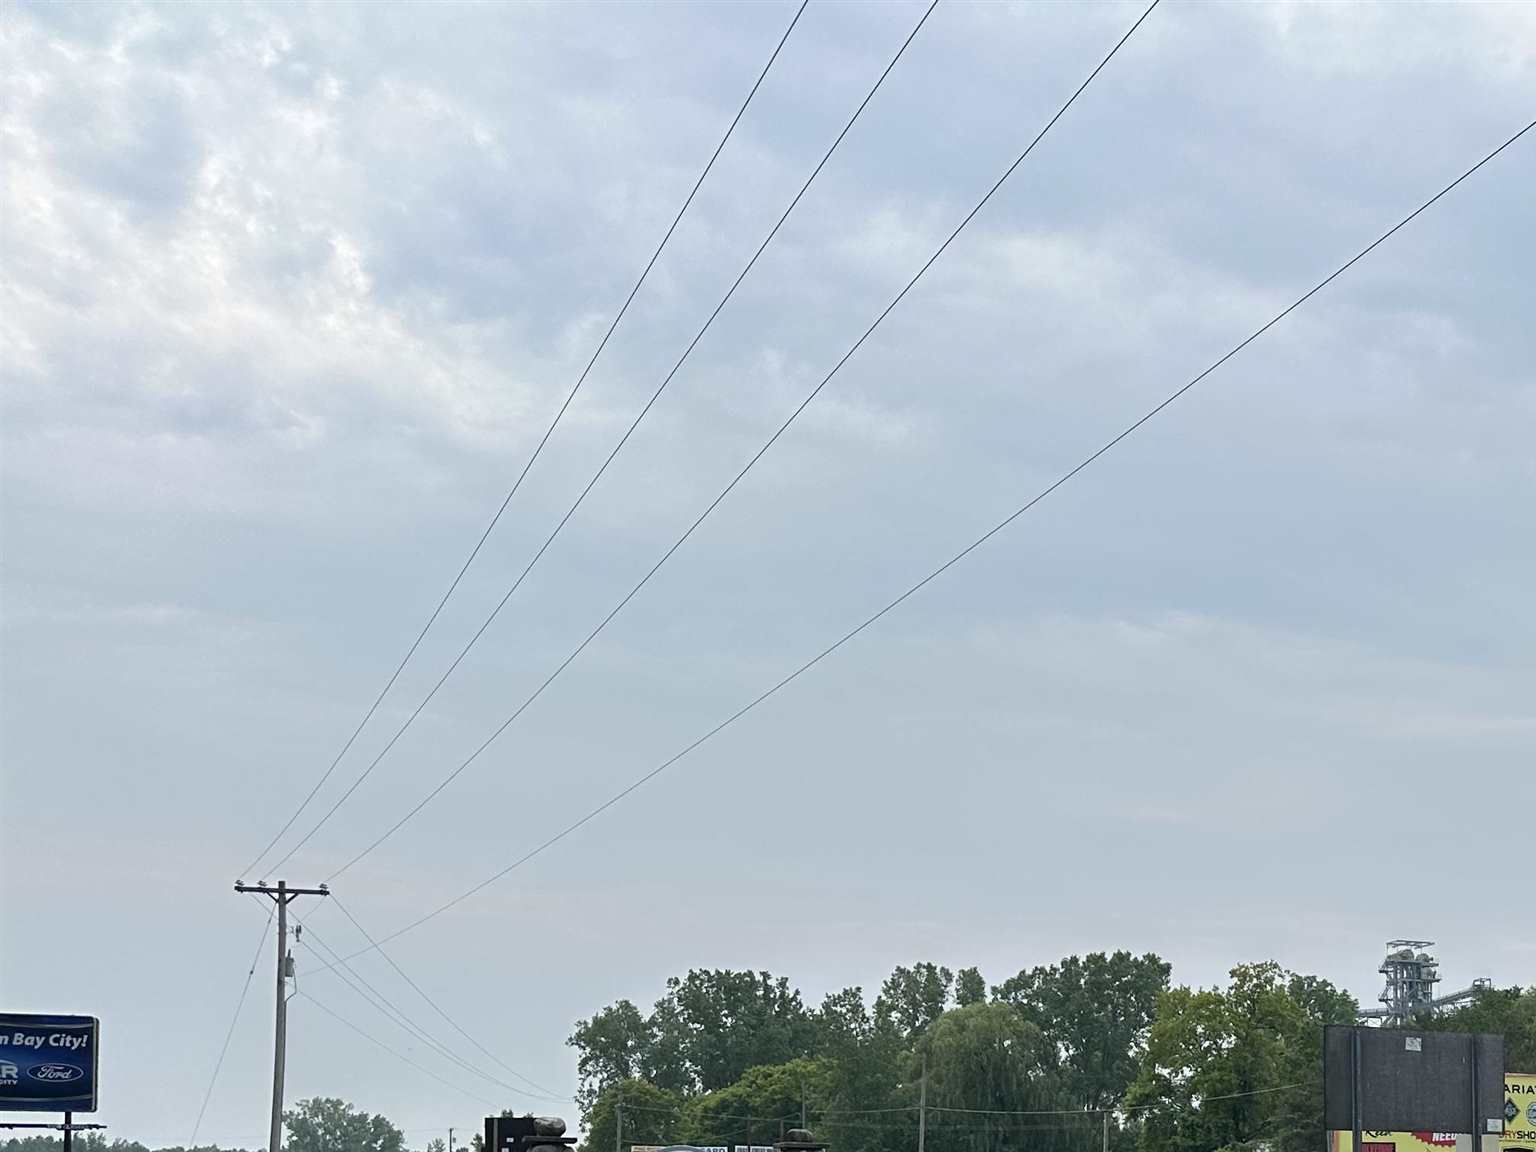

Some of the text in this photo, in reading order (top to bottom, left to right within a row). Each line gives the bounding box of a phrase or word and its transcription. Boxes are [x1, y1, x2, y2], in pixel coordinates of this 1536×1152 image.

[12, 1033, 46, 1050] Bay
[48, 1033, 88, 1050] City!
[37, 1064, 73, 1079] Ford
